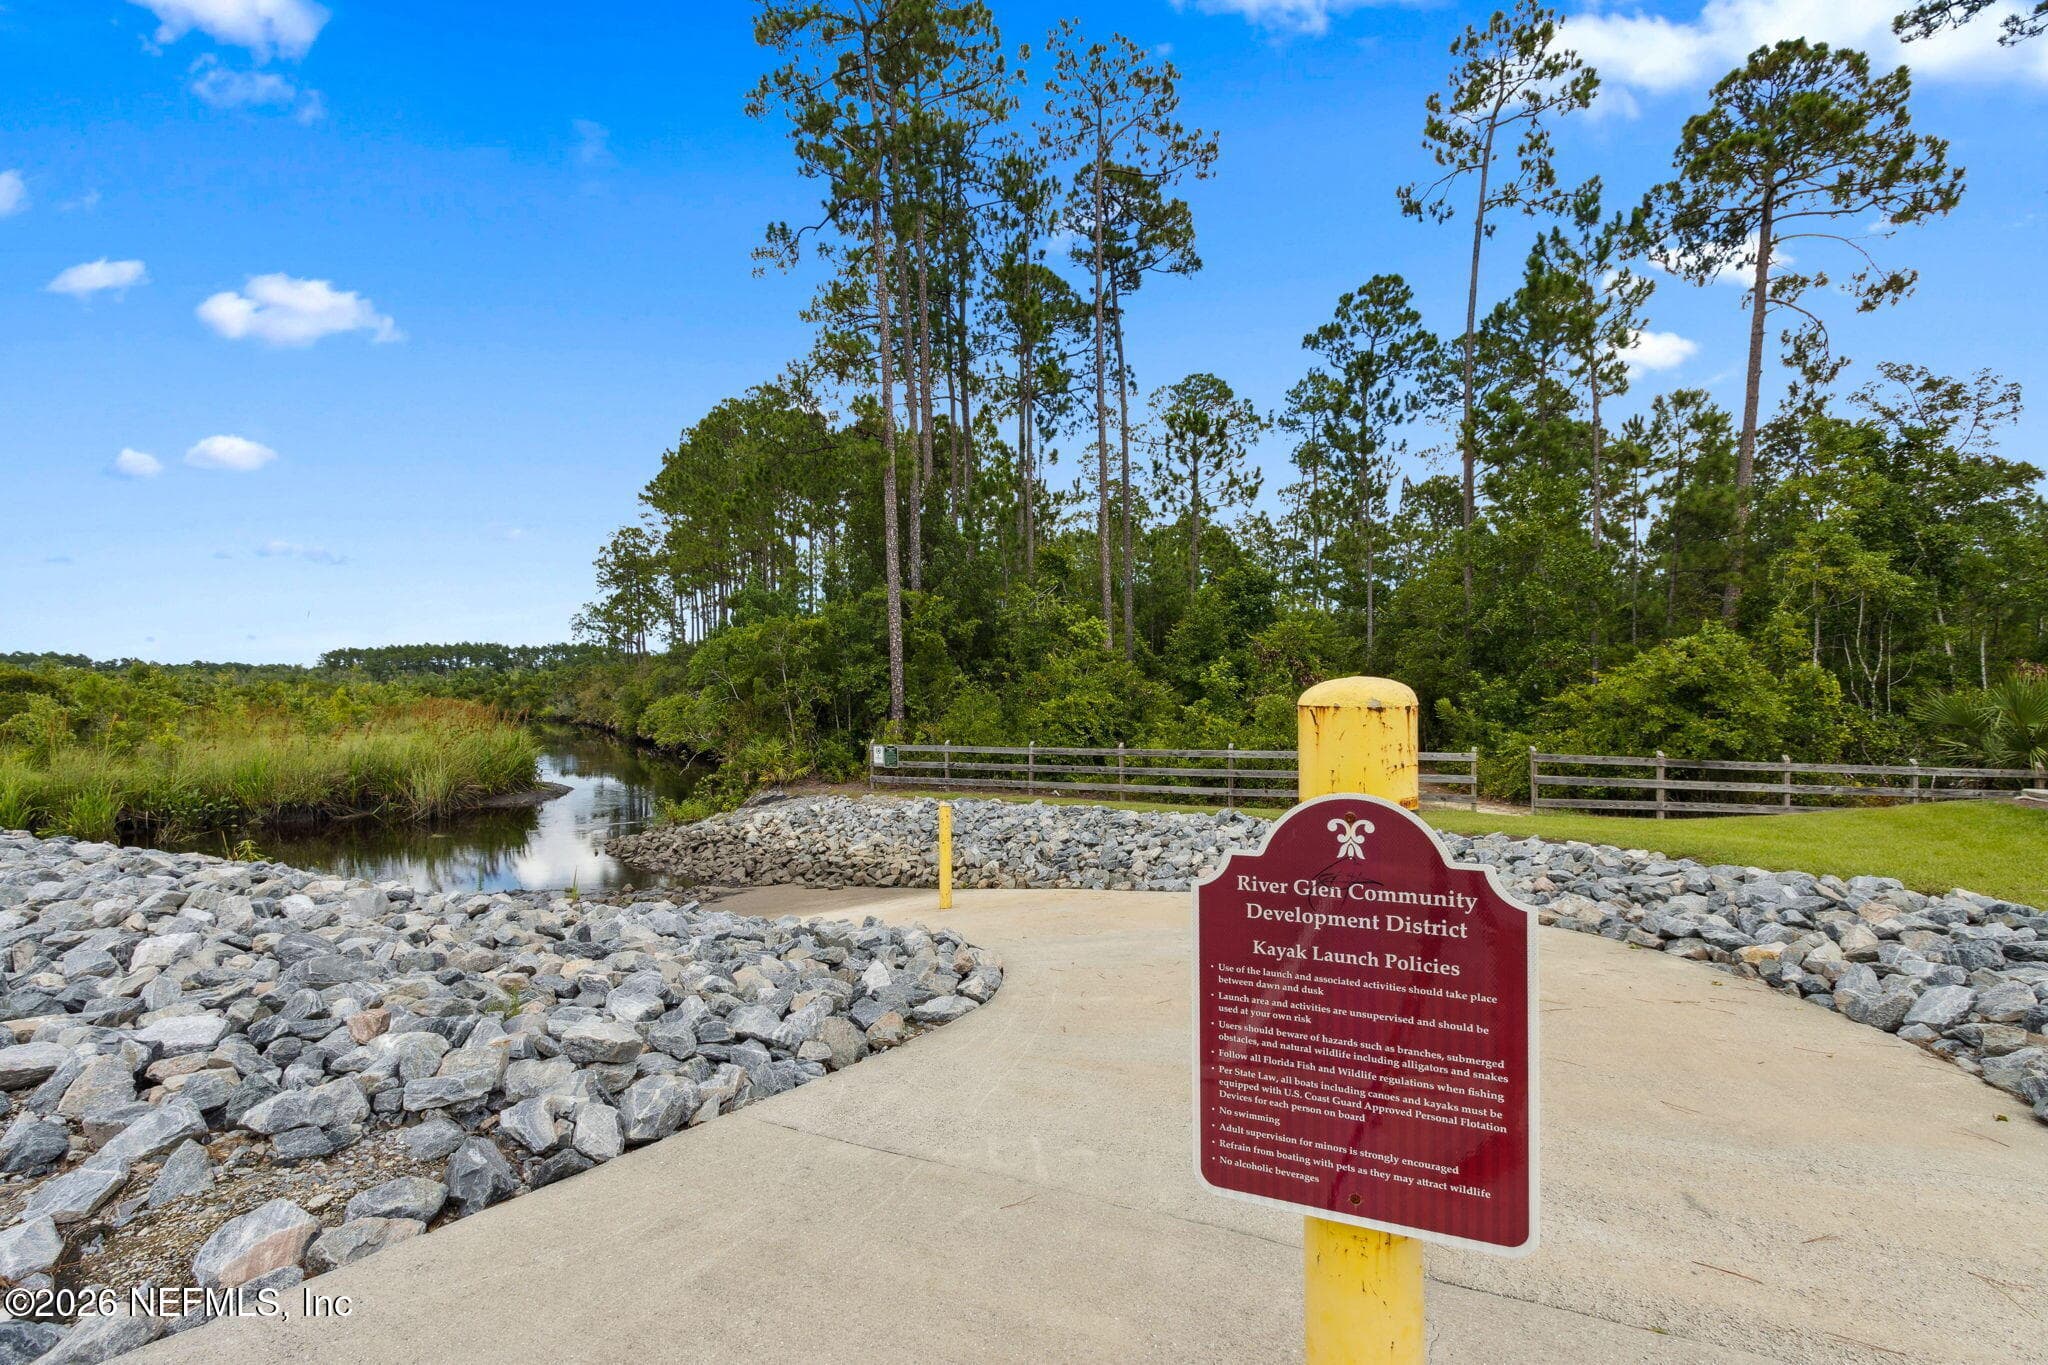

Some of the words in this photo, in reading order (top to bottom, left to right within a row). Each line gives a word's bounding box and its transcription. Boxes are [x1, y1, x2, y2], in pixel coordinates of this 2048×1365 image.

[1237, 874, 1289, 895] River
[1293, 879, 1342, 899] Glen
[1348, 883, 1477, 915] Community
[1246, 902, 1380, 931] Development
[1386, 914, 1468, 940] District
[1252, 939, 1308, 962] Kayak
[1312, 945, 1380, 968] Launch
[1384, 953, 1461, 977] Policies
[1218, 963, 1235, 972] Use
[1246, 967, 1261, 975] the
[1262, 968, 1293, 979] launch
[1294, 973, 1312, 981] and
[1313, 976, 1362, 987] associated
[1362, 981, 1407, 993] activities
[1408, 986, 1444, 997] should
[1445, 990, 1468, 1000] take
[1469, 993, 1498, 1004] place
[1218, 975, 1254, 987] between
[1256, 980, 1280, 990] dawn
[1282, 984, 1299, 992] and
[1301, 985, 1324, 996] dusk
[1218, 992, 1250, 1003] Launch
[1271, 1000, 1288, 1008] and
[1290, 1002, 1331, 1014] activities
[1332, 1008, 1348, 1016] are
[1349, 1010, 1415, 1025] unsupervised
[1416, 1019, 1436, 1028] and
[1438, 1021, 1474, 1033] should
[1476, 1024, 1490, 1035] be
[1218, 1006, 1238, 1014] used
[1250, 1010, 1271, 1018] your
[1272, 1013, 1292, 1021] own
[1294, 1014, 1312, 1024] risk
[1218, 1020, 1242, 1031] Users
[1244, 1024, 1274, 1035] should
[1276, 1028, 1308, 1040] beware
[1309, 1034, 1320, 1042] of
[1321, 1034, 1359, 1048] hazards
[1359, 1042, 1383, 1051] such
[1397, 1045, 1445, 1061] branches,
[1446, 1054, 1505, 1069] submerged
[1218, 1033, 1260, 1047] obstacles,
[1261, 1040, 1278, 1048] and
[1280, 1043, 1312, 1053] natural
[1314, 1047, 1352, 1059] wildlife
[1353, 1052, 1400, 1069] including
[1402, 1060, 1449, 1074] alligators
[1450, 1069, 1470, 1077] and
[1472, 1072, 1509, 1083] snakes
[1218, 1049, 1248, 1060] Follow
[1250, 1054, 1262, 1062] all
[1263, 1056, 1295, 1068] Florida
[1296, 1061, 1316, 1071] Fish
[1318, 1066, 1336, 1074] and
[1338, 1067, 1377, 1081] Wildlife
[1379, 1076, 1435, 1090] regulations
[1436, 1084, 1465, 1095] when
[1467, 1087, 1505, 1103] fishing
[1218, 1065, 1233, 1075] Per
[1234, 1068, 1256, 1078] State
[1258, 1072, 1279, 1083] Law,
[1280, 1076, 1292, 1084] all
[1294, 1077, 1319, 1089] boats
[1320, 1081, 1366, 1099] including
[1367, 1092, 1400, 1102] canoes
[1402, 1097, 1422, 1105] and
[1423, 1098, 1459, 1112] kayaks
[1461, 1107, 1488, 1116] must
[1489, 1109, 1503, 1119] be
[1218, 1080, 1260, 1092] equipped
[1261, 1086, 1282, 1095] with
[1284, 1088, 1303, 1099] U.S.
[1304, 1092, 1330, 1103] Coast
[1332, 1097, 1362, 1109] Guard
[1364, 1102, 1413, 1118] Approved
[1414, 1110, 1458, 1125] Personal
[1460, 1118, 1508, 1134] Flotation
[1219, 1090, 1253, 1103] Devices
[1254, 1096, 1268, 1105] for
[1268, 1100, 1289, 1109] each
[1291, 1104, 1322, 1115] person
[1337, 1110, 1366, 1122] board
[1219, 1106, 1233, 1116] No
[1233, 1111, 1281, 1126] swimming
[1219, 1123, 1245, 1135] Adult
[1245, 1130, 1298, 1144] supervision
[1299, 1137, 1313, 1147] for
[1314, 1142, 1348, 1154] minors
[1349, 1147, 1358, 1156] is
[1359, 1150, 1400, 1165] strongly
[1401, 1159, 1460, 1175] encouraged
[1219, 1139, 1251, 1152] Refrain
[1253, 1146, 1275, 1157] from
[1276, 1150, 1311, 1166] boating
[1312, 1158, 1334, 1169] with
[1336, 1164, 1356, 1173] pets
[1369, 1168, 1391, 1181] they
[1393, 1175, 1415, 1186] may
[1416, 1178, 1448, 1190] attract
[1450, 1185, 1492, 1199] wildlife
[1219, 1156, 1233, 1166] No
[1234, 1160, 1274, 1174] alcoholic
[1274, 1167, 1320, 1183] beverages
